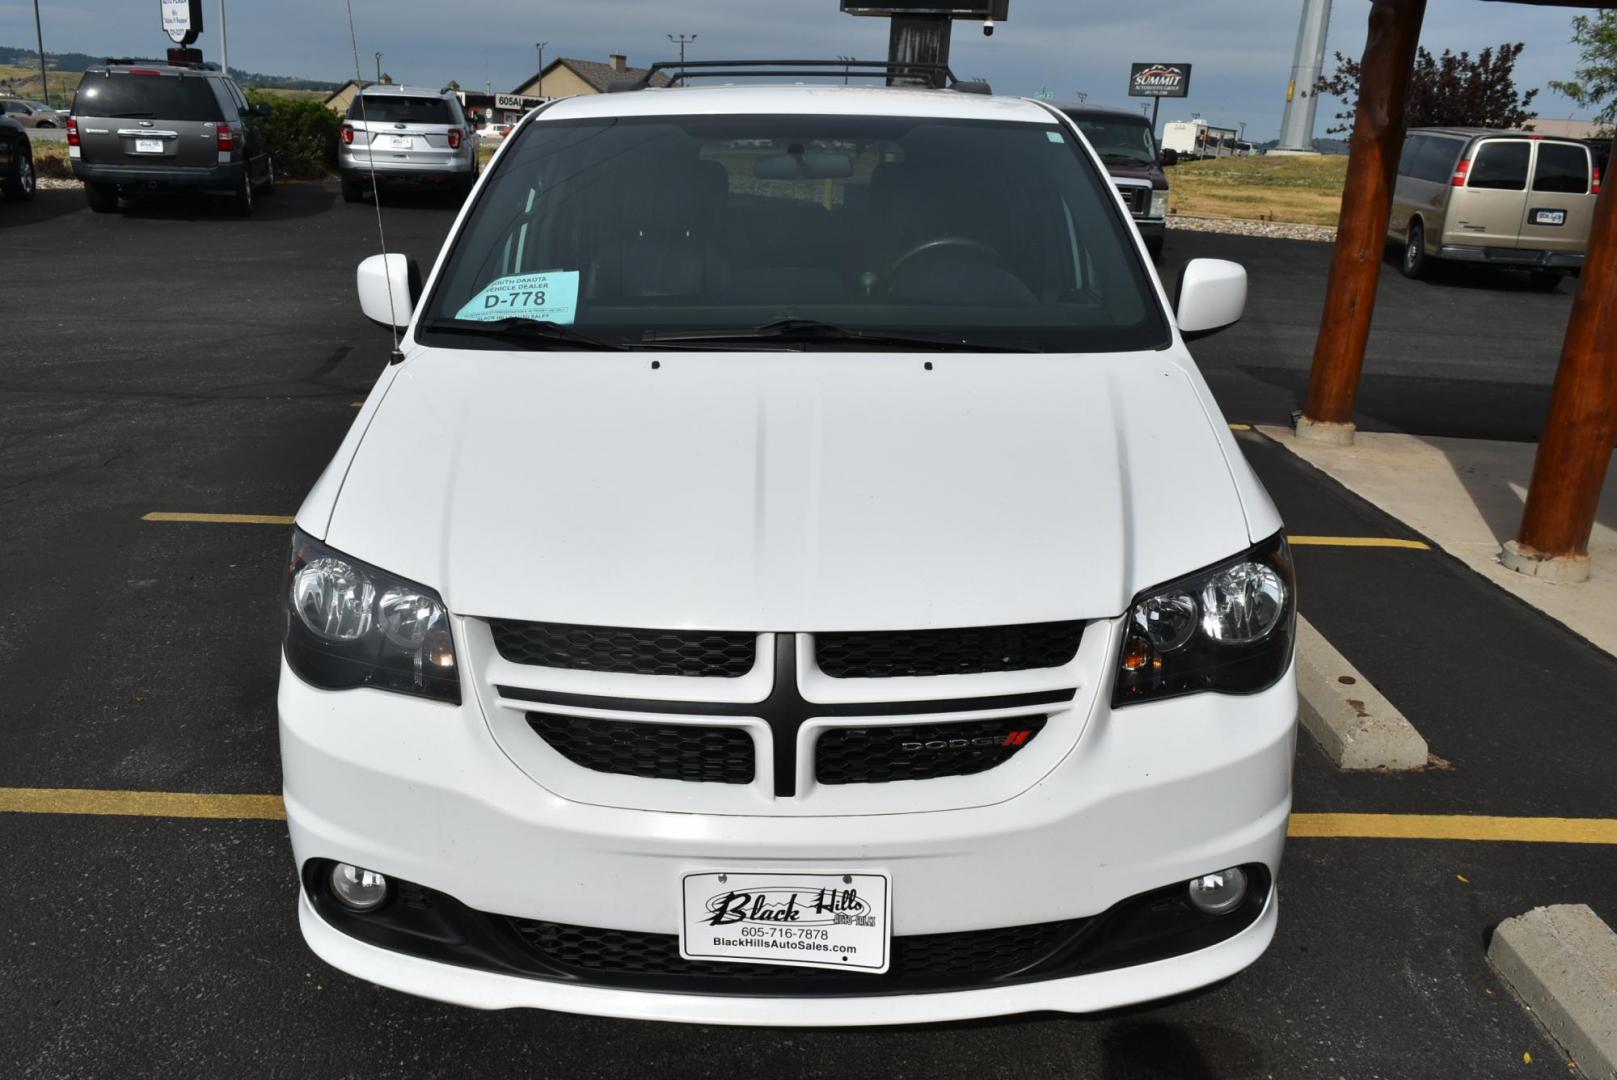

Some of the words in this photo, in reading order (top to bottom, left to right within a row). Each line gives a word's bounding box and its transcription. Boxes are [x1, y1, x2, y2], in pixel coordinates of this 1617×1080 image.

[1134, 76, 1182, 86] SUMMIT
[484, 291, 546, 309] D-778
[901, 735, 1007, 750] DODGE
[700, 892, 801, 926] Black
[809, 886, 863, 914] Hills
[741, 926, 829, 941] 605-716-7878
[713, 937, 857, 954] BlackHillsAutoSales.com
